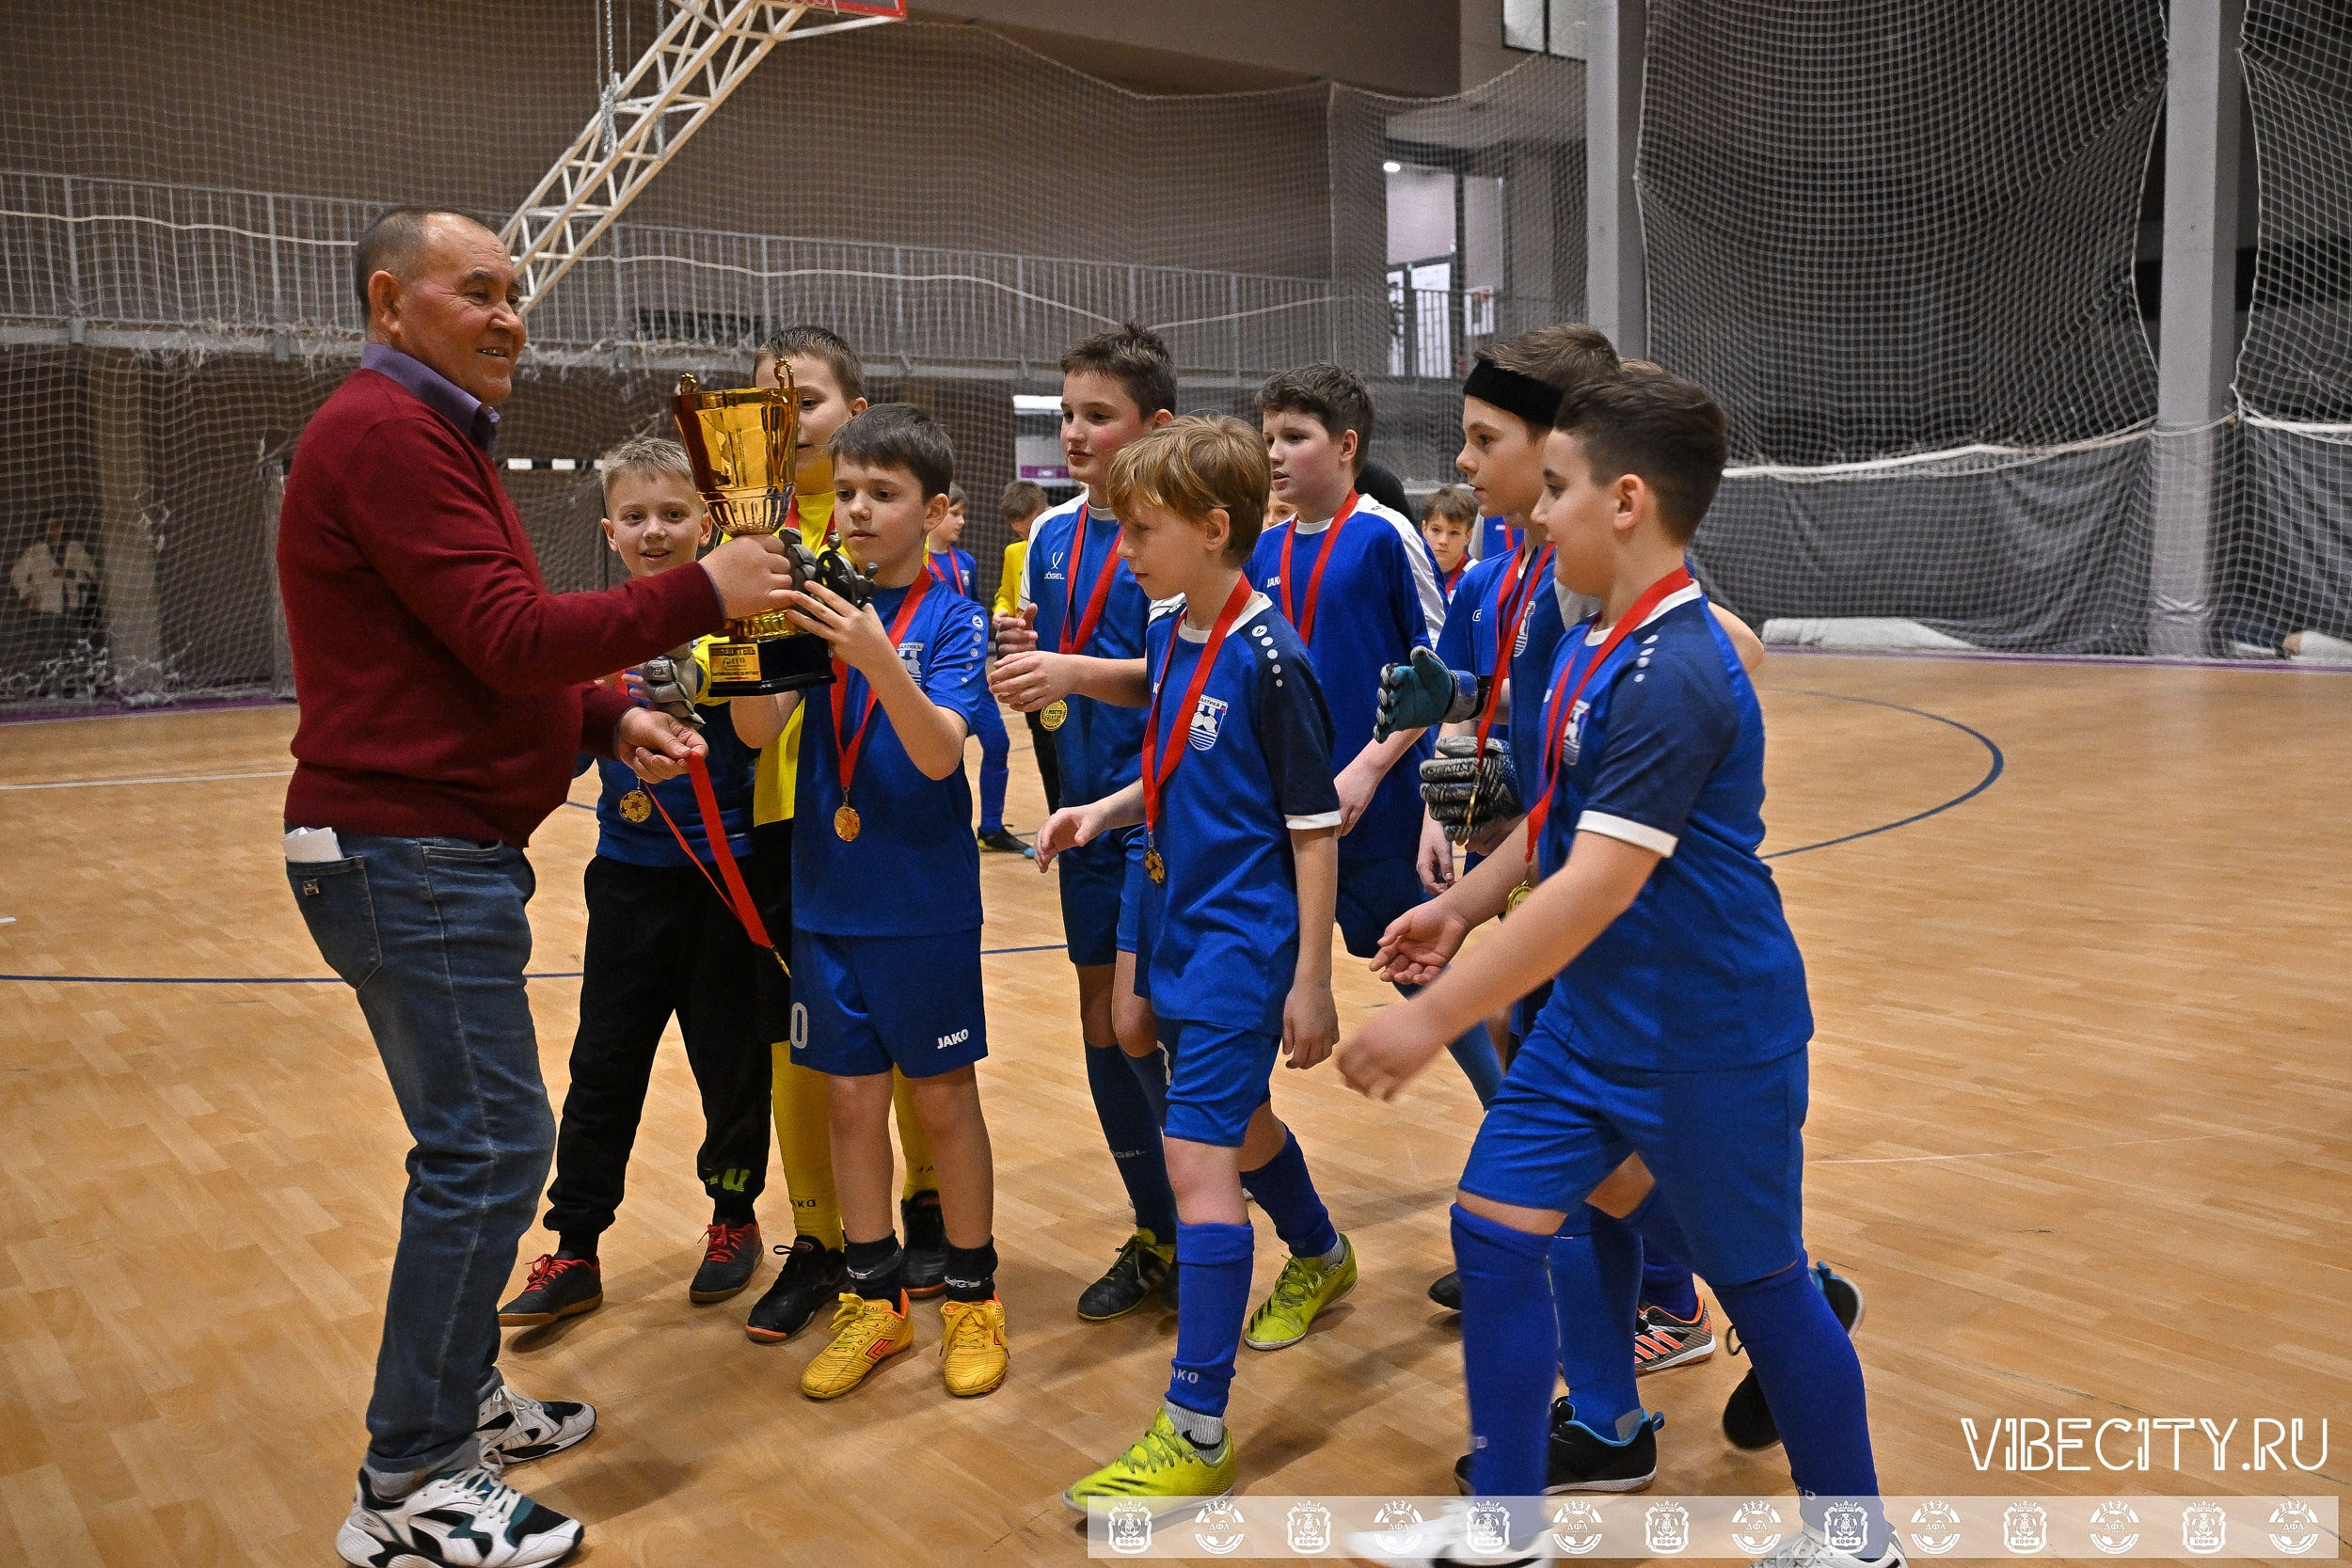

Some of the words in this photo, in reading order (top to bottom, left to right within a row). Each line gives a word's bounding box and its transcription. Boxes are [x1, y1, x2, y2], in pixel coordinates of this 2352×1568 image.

[1200, 697, 1220, 707] АЛТИКА
[937, 1028, 969, 1050] JAKO
[790, 1198, 817, 1209] AKO
